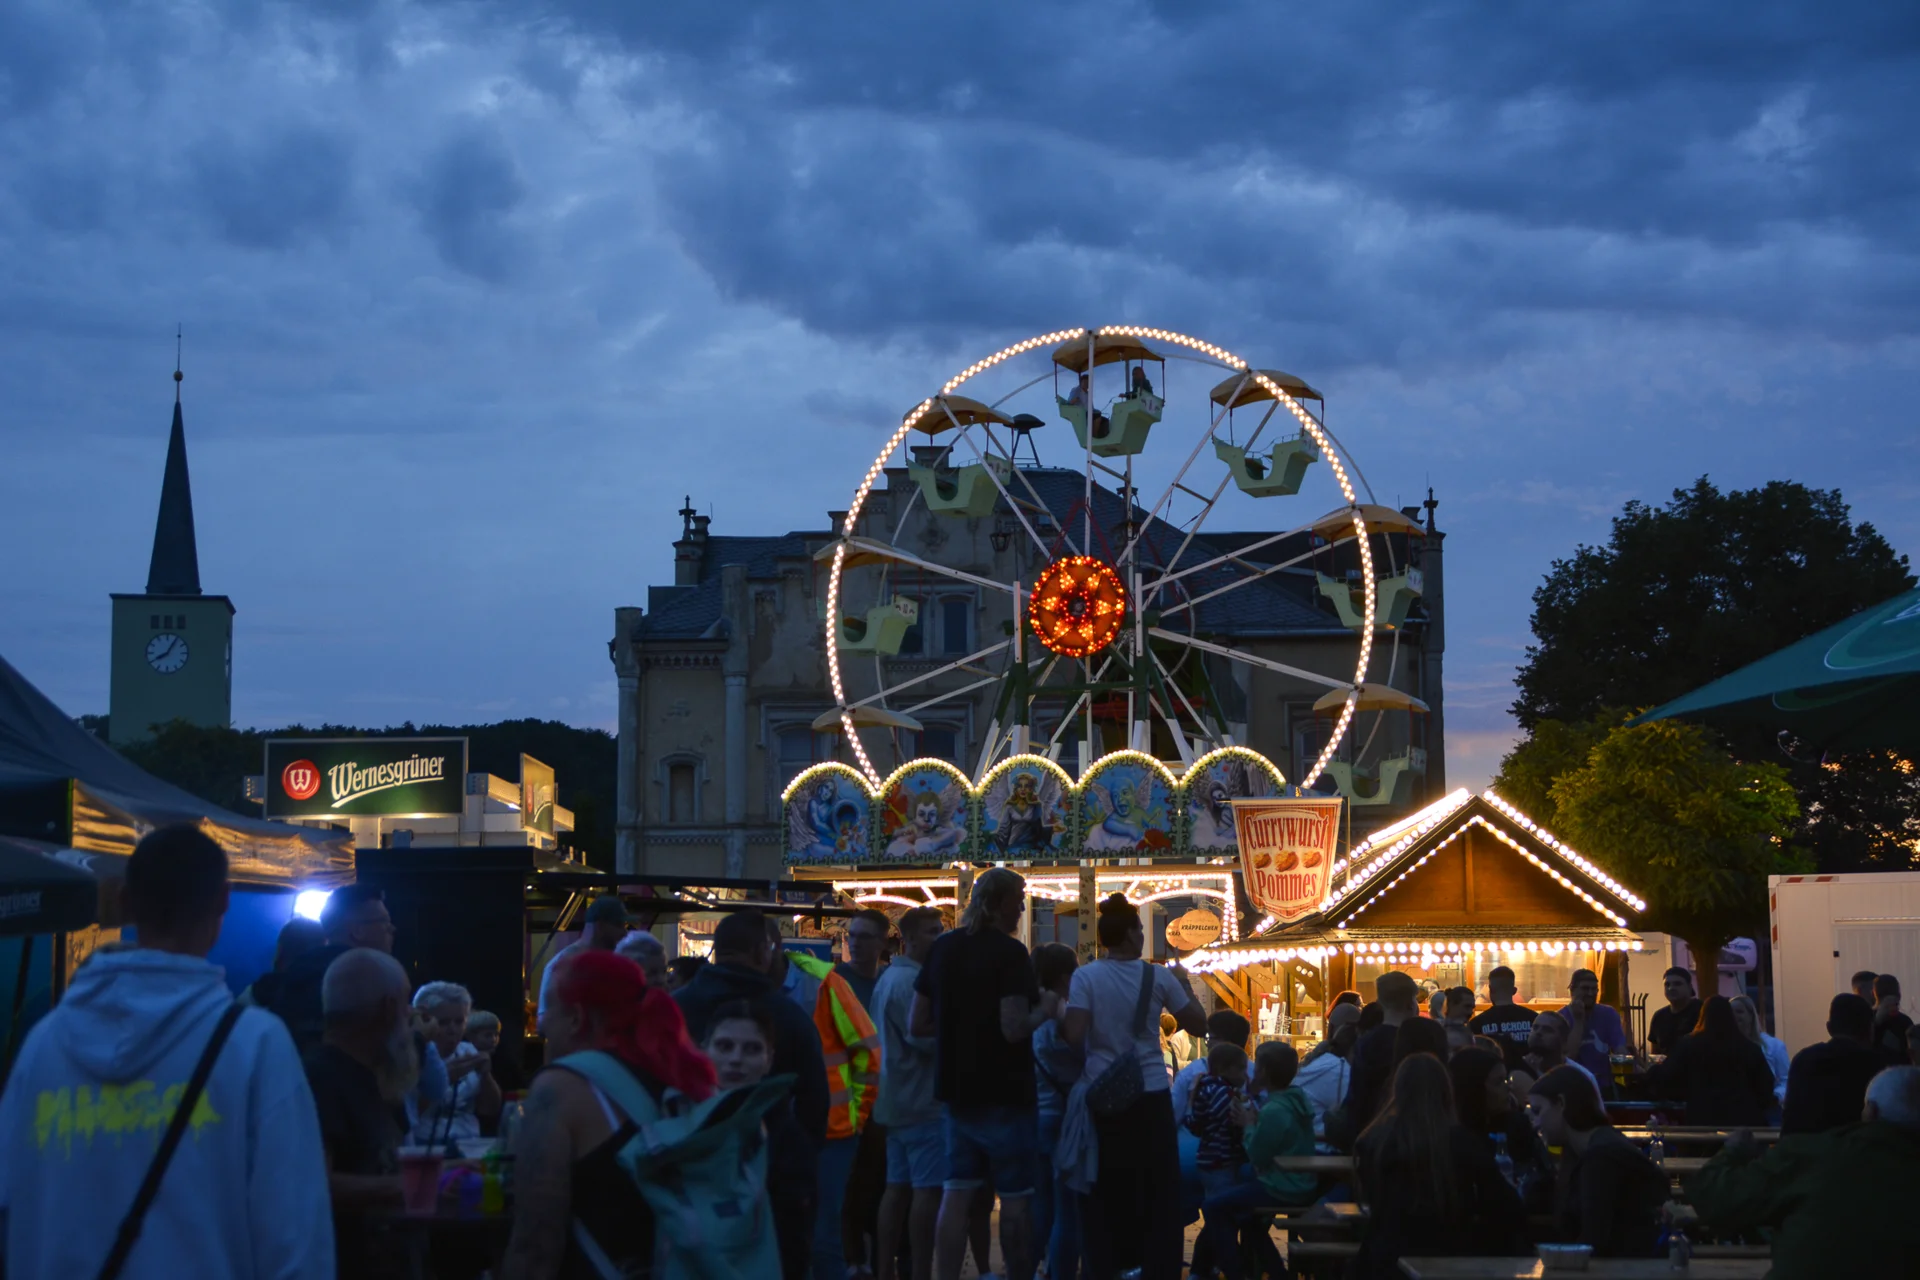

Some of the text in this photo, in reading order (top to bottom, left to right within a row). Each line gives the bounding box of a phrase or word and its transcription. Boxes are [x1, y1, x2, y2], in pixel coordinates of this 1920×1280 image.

[328, 754, 445, 801] Wernesgrüner
[1245, 814, 1330, 851] Currywurst
[1255, 869, 1317, 901] Pommes
[1482, 1021, 1532, 1034] OLD SCHOOL
